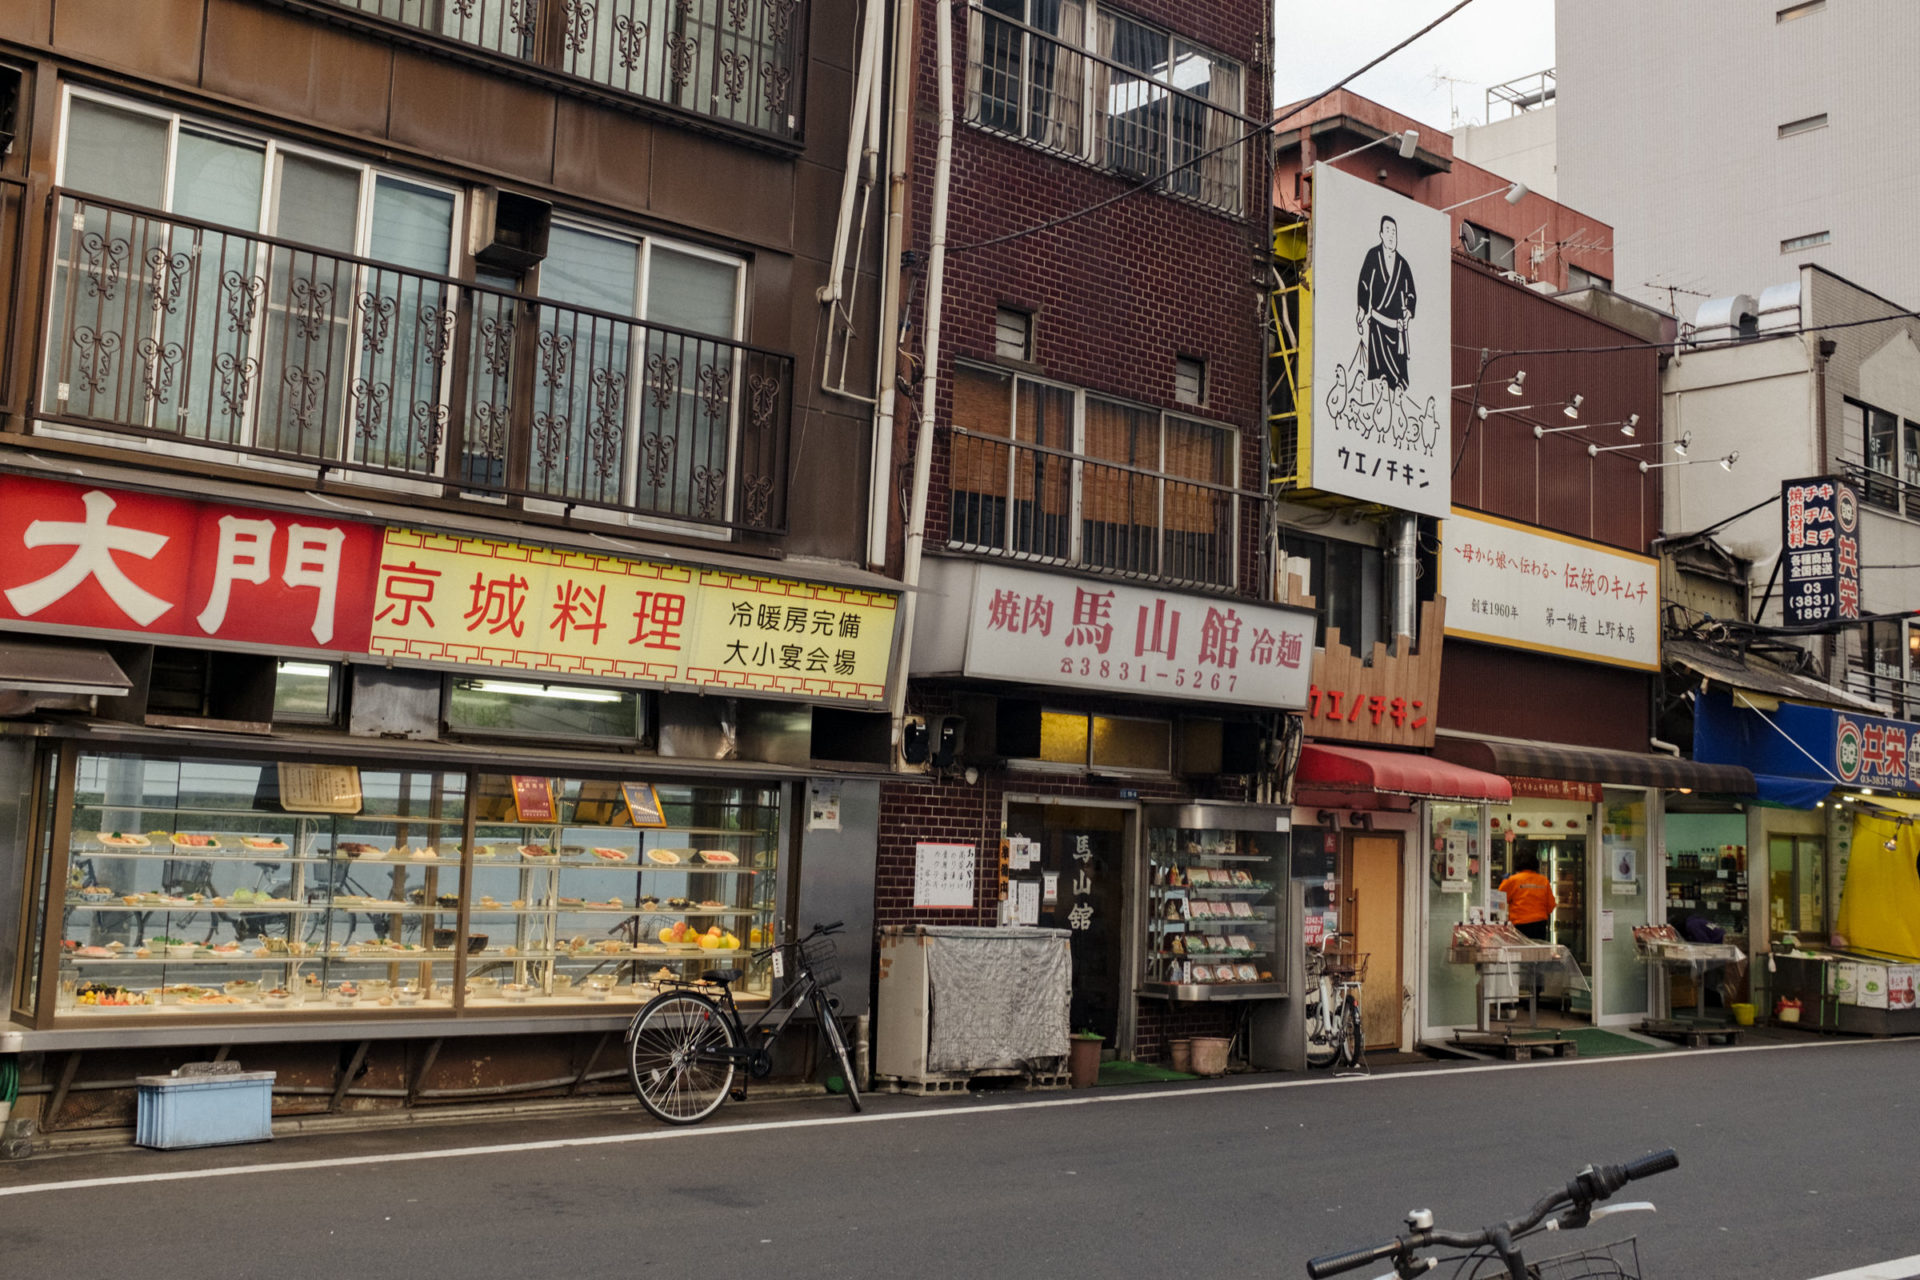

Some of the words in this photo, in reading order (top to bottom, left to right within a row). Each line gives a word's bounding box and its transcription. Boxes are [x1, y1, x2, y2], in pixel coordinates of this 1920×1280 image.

[1338, 446, 1430, 488] ウエノチキン
[1819, 484, 1834, 545] キムチ
[4, 490, 346, 645] 大門
[1564, 562, 1648, 605] 伝統のキムチ
[1803, 582, 1821, 594] 03
[1838, 535, 1858, 619] 共栄
[374, 561, 686, 652] 京城料理
[729, 601, 862, 639] 冷暖房完備
[1790, 593, 1835, 608] (3831)
[1796, 606, 1830, 620] 1867
[1064, 586, 1243, 669] 馬山館
[1546, 607, 1588, 634] 第一物産
[1595, 620, 1635, 643] 上野本店
[723, 639, 857, 676] 大小宴会場
[1862, 723, 1906, 777] 共栄
